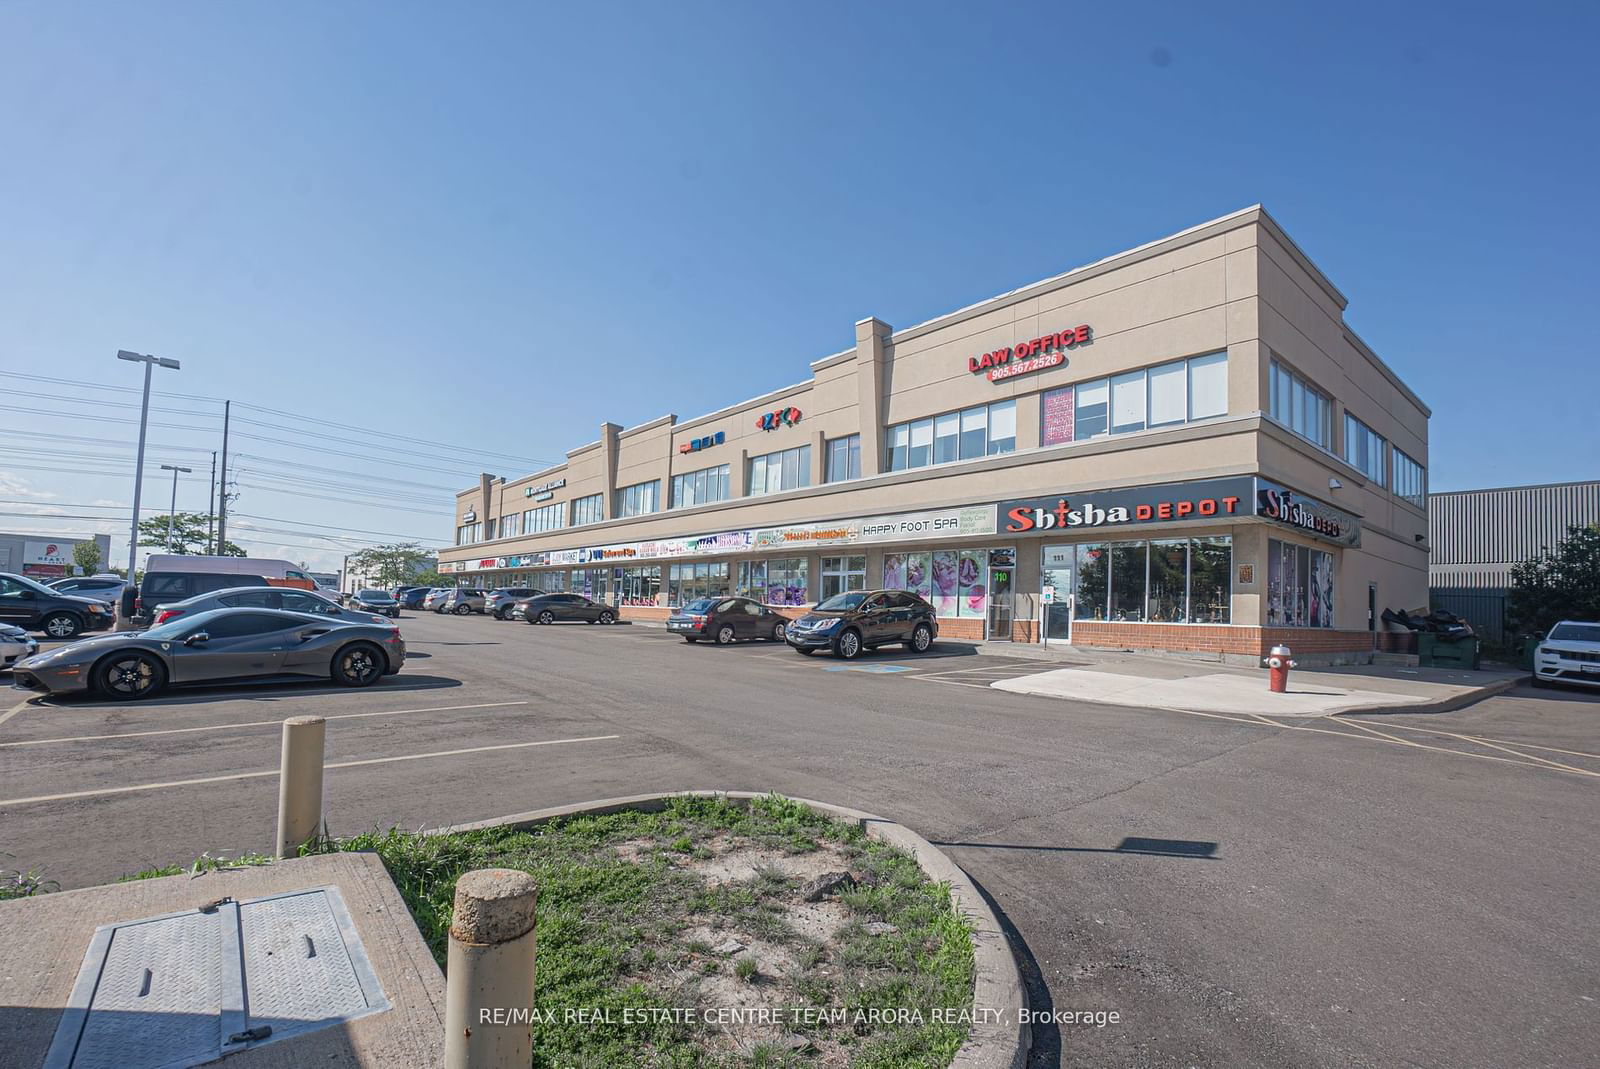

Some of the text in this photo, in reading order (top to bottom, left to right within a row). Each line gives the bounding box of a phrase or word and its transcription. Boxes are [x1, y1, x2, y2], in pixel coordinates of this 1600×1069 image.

[969, 325, 1089, 372] LAW OFFICE
[991, 354, 1058, 380] 905.567.2526
[1006, 496, 1240, 532] Shisha DEPOT
[1266, 489, 1315, 530] Shisha
[863, 524, 898, 536] HAPPY
[900, 520, 930, 533] FOOT
[934, 518, 958, 530] SPA
[994, 572, 1007, 582] 110
